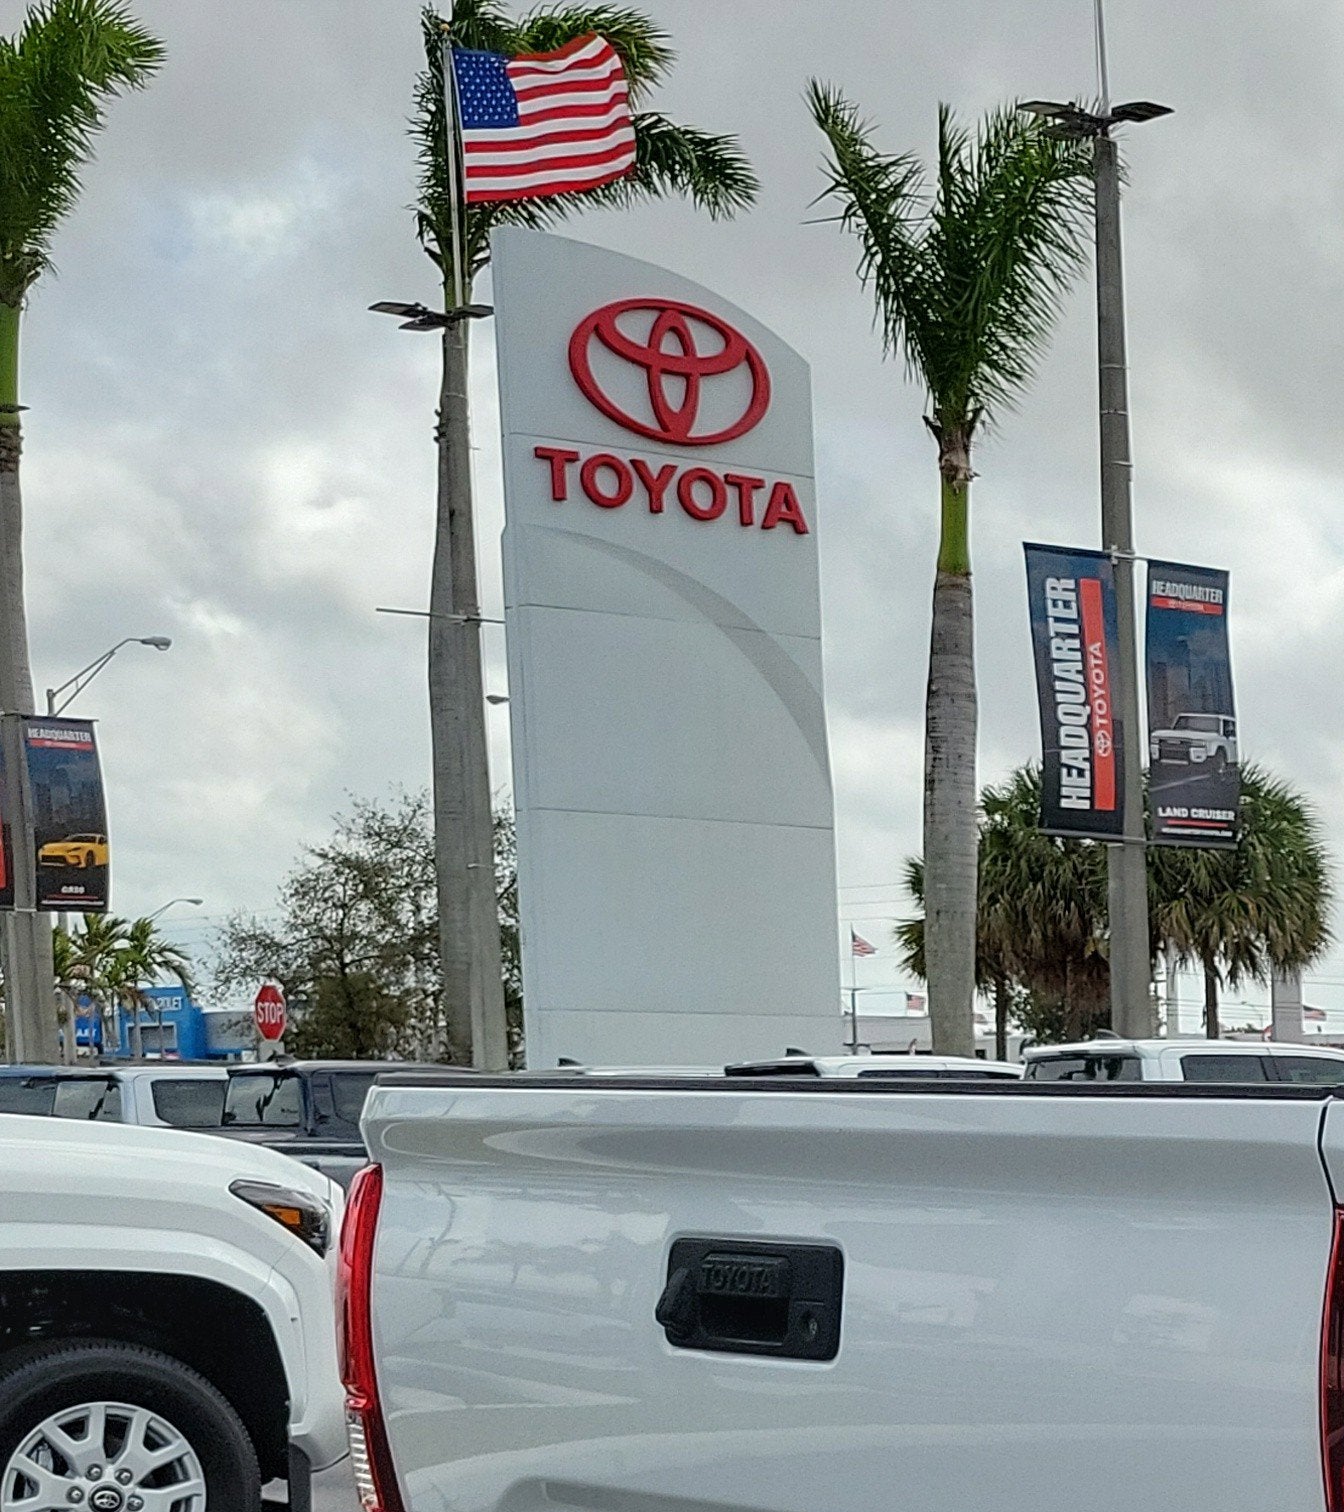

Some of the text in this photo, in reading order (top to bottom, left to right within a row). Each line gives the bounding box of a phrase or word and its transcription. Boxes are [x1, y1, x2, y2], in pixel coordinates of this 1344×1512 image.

[534, 446, 809, 535] TOYOTA
[1151, 580, 1223, 604] HEADQUARTER
[1045, 577, 1092, 810] HEADQUARTER
[1088, 642, 1109, 728] TOYOTA
[27, 727, 92, 743] HEADQUARTER
[1158, 806, 1236, 821] LAND CRUISER
[257, 1002, 285, 1024] STOP
[701, 1263, 776, 1294] TOYOTA
